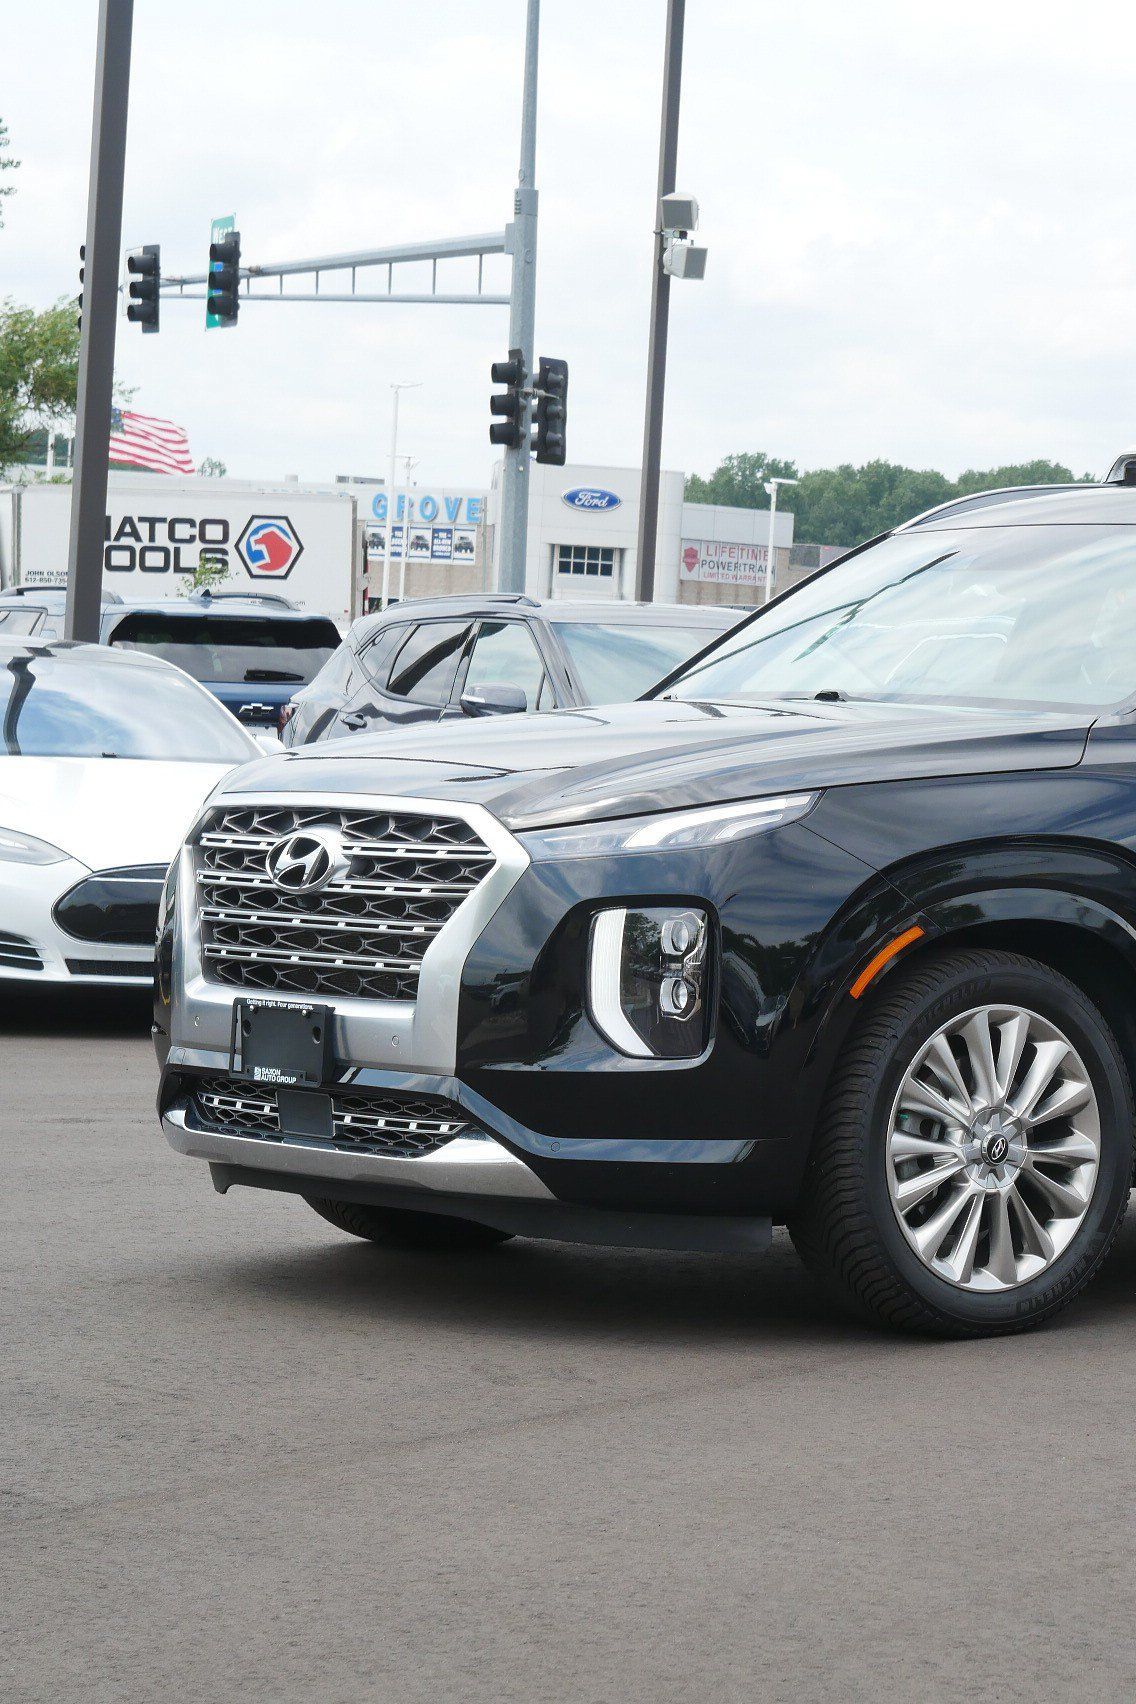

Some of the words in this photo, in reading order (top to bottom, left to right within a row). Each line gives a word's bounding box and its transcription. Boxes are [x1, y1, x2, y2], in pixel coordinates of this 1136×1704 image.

[372, 493, 481, 522] GROVE
[574, 491, 610, 508] Ford
[105, 515, 230, 544] ATCO
[105, 544, 230, 574] OOLS
[706, 544, 769, 562] LIFETIME
[702, 571, 730, 581] LIMITED
[731, 573, 769, 584] WARRANT
[246, 998, 262, 1007] Getting
[260, 1073, 276, 1082] AUTO
[276, 1075, 297, 1084] GROUP
[261, 1067, 282, 1076] SAXON
